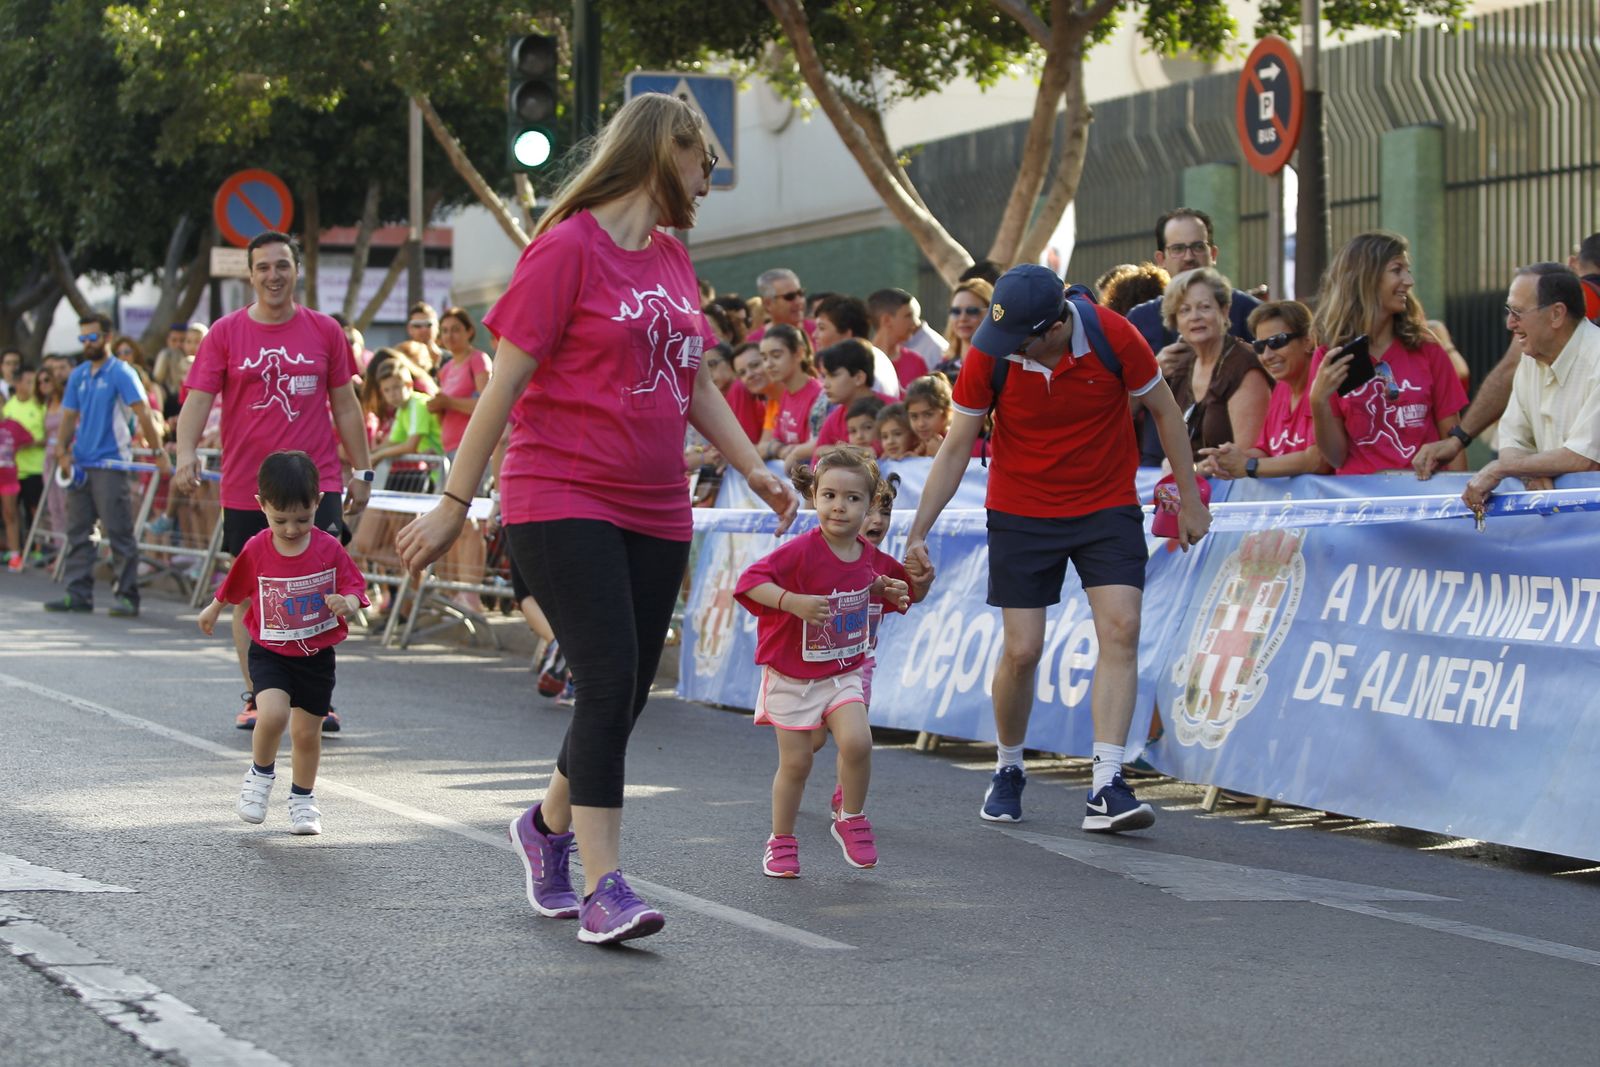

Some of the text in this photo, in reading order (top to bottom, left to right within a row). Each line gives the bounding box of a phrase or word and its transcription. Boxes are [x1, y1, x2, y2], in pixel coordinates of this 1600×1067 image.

[1263, 97, 1271, 115] P
[1258, 127, 1276, 143] BUS
[283, 593, 323, 615] 175
[1293, 641, 1358, 707] DE
[1352, 645, 1526, 731] ALMERÍA
